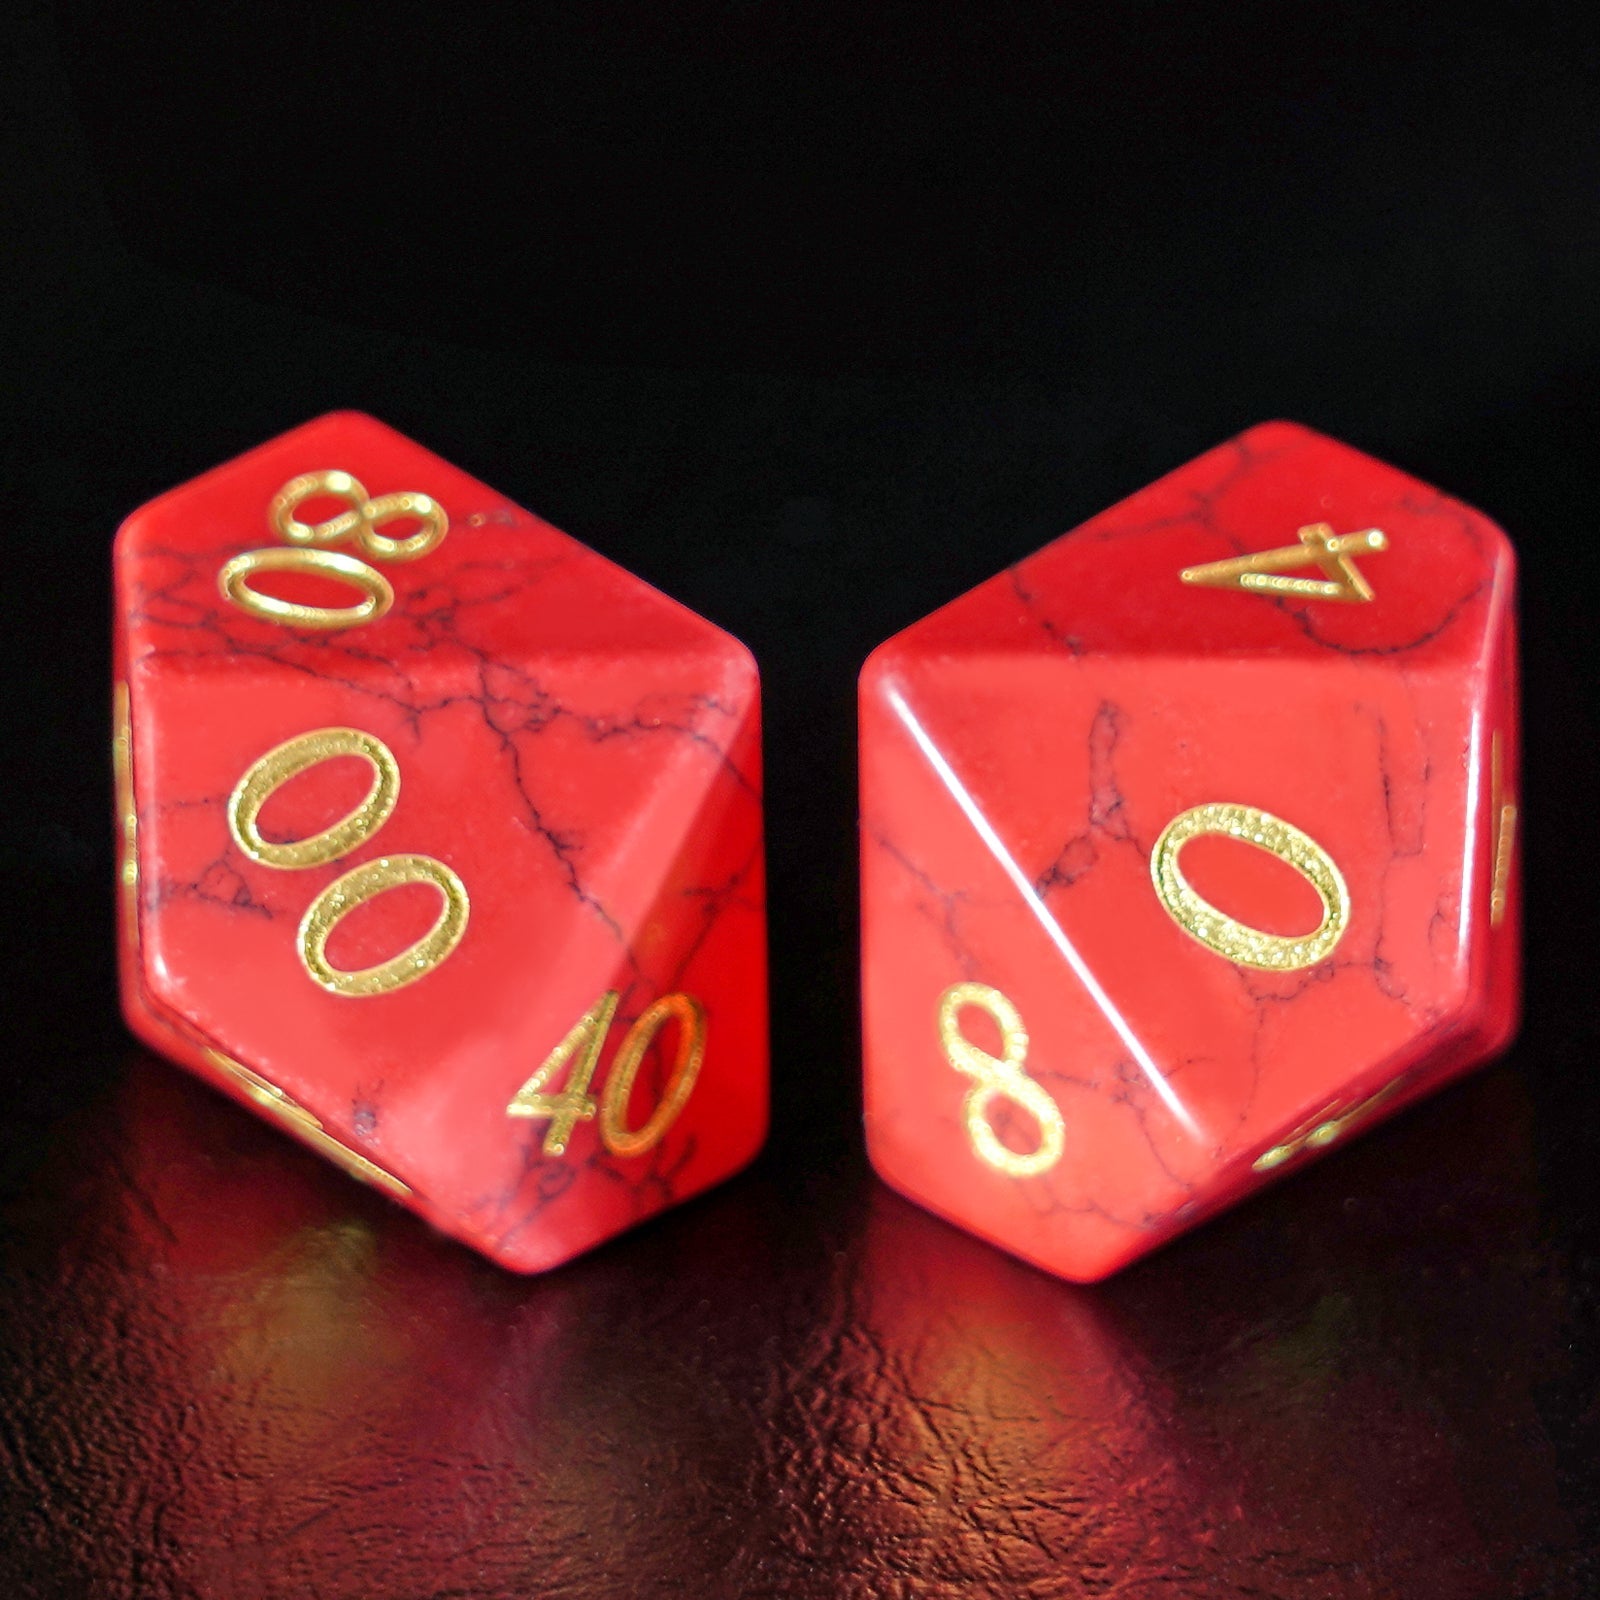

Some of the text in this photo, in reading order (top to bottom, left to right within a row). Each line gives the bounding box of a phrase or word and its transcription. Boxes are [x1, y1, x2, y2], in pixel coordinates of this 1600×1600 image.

[218, 469, 449, 630] 80
[1180, 523, 1388, 602] 4
[228, 727, 470, 998] 00
[1150, 803, 1349, 971] 0
[508, 990, 707, 1157] 40
[938, 982, 1065, 1177] 8
